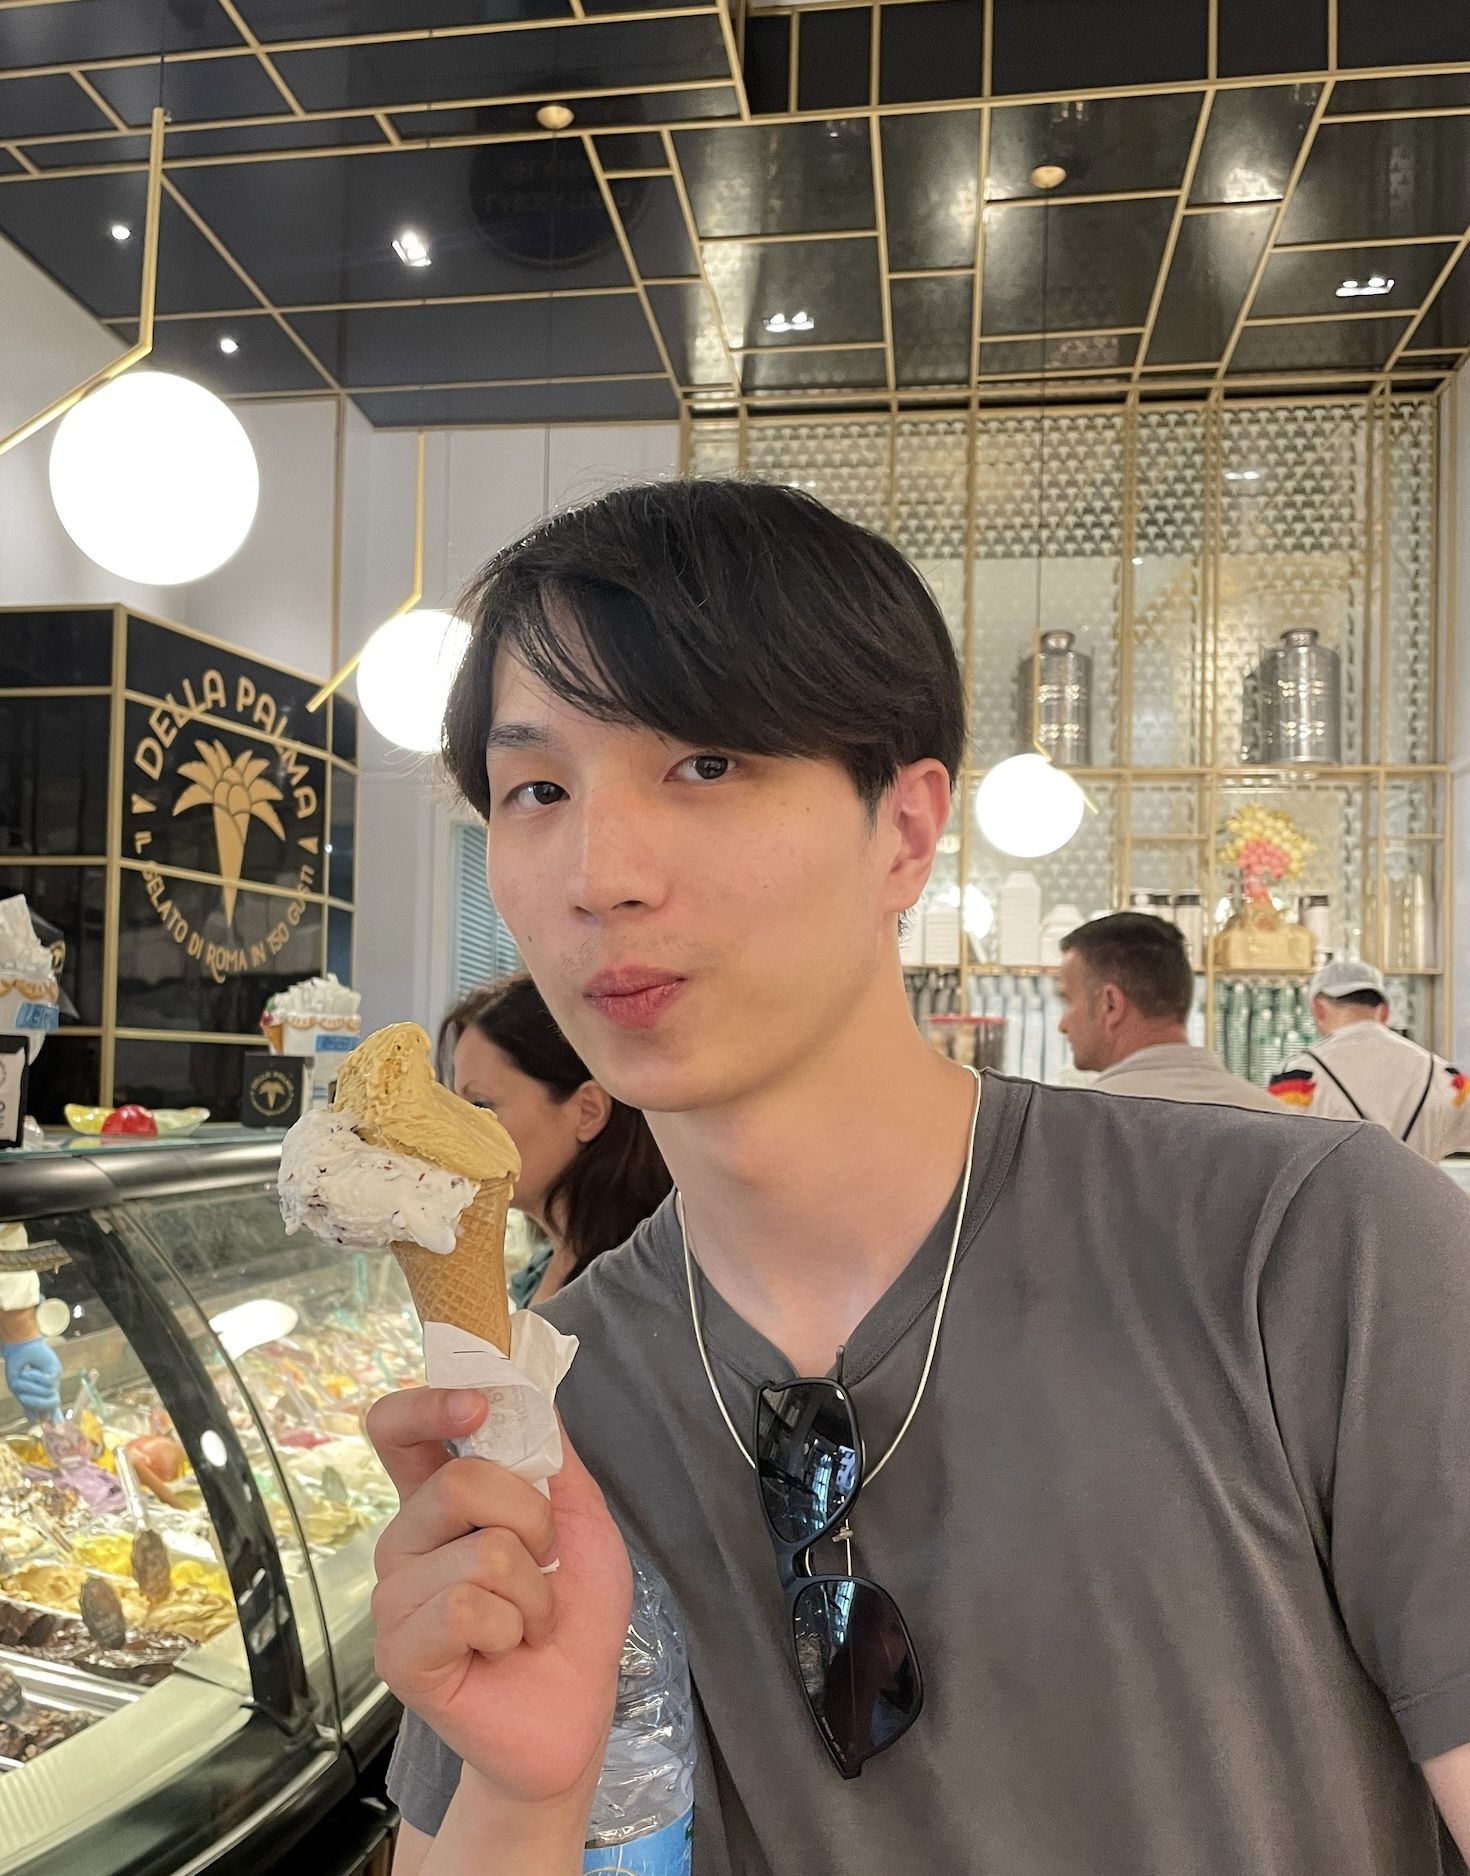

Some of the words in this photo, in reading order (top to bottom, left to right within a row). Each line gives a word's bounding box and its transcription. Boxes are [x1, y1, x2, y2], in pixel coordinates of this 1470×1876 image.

[134, 669, 227, 781] DELLA
[236, 675, 318, 818] PALMA
[134, 830, 152, 855] IL
[187, 932, 204, 960] DI
[206, 943, 248, 984] ROMA
[251, 941, 267, 967] IN
[266, 922, 290, 955] 150
